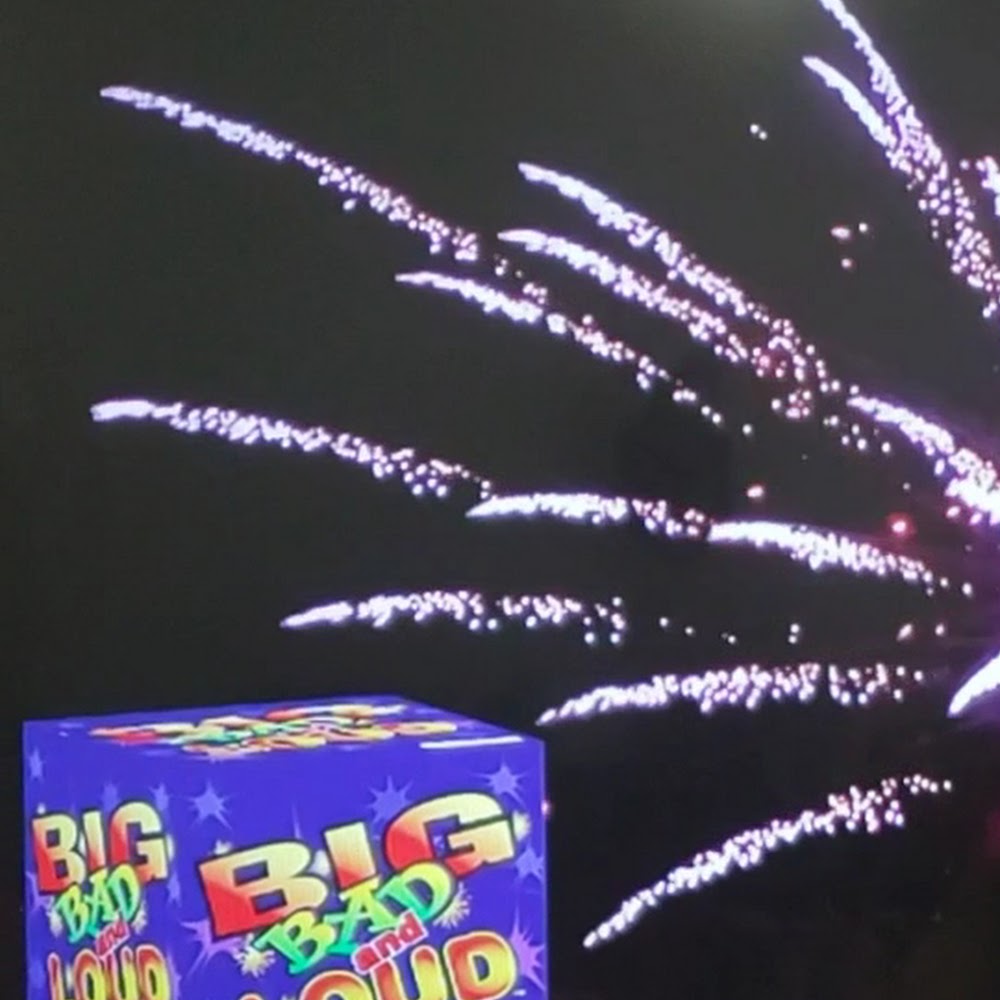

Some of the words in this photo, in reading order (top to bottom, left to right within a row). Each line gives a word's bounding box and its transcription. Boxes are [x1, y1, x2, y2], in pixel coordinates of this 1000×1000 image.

[33, 801, 168, 892] BIG
[199, 792, 517, 938] BIG
[56, 863, 141, 943] BAD
[254, 862, 455, 974] BAD
[352, 911, 428, 974] and
